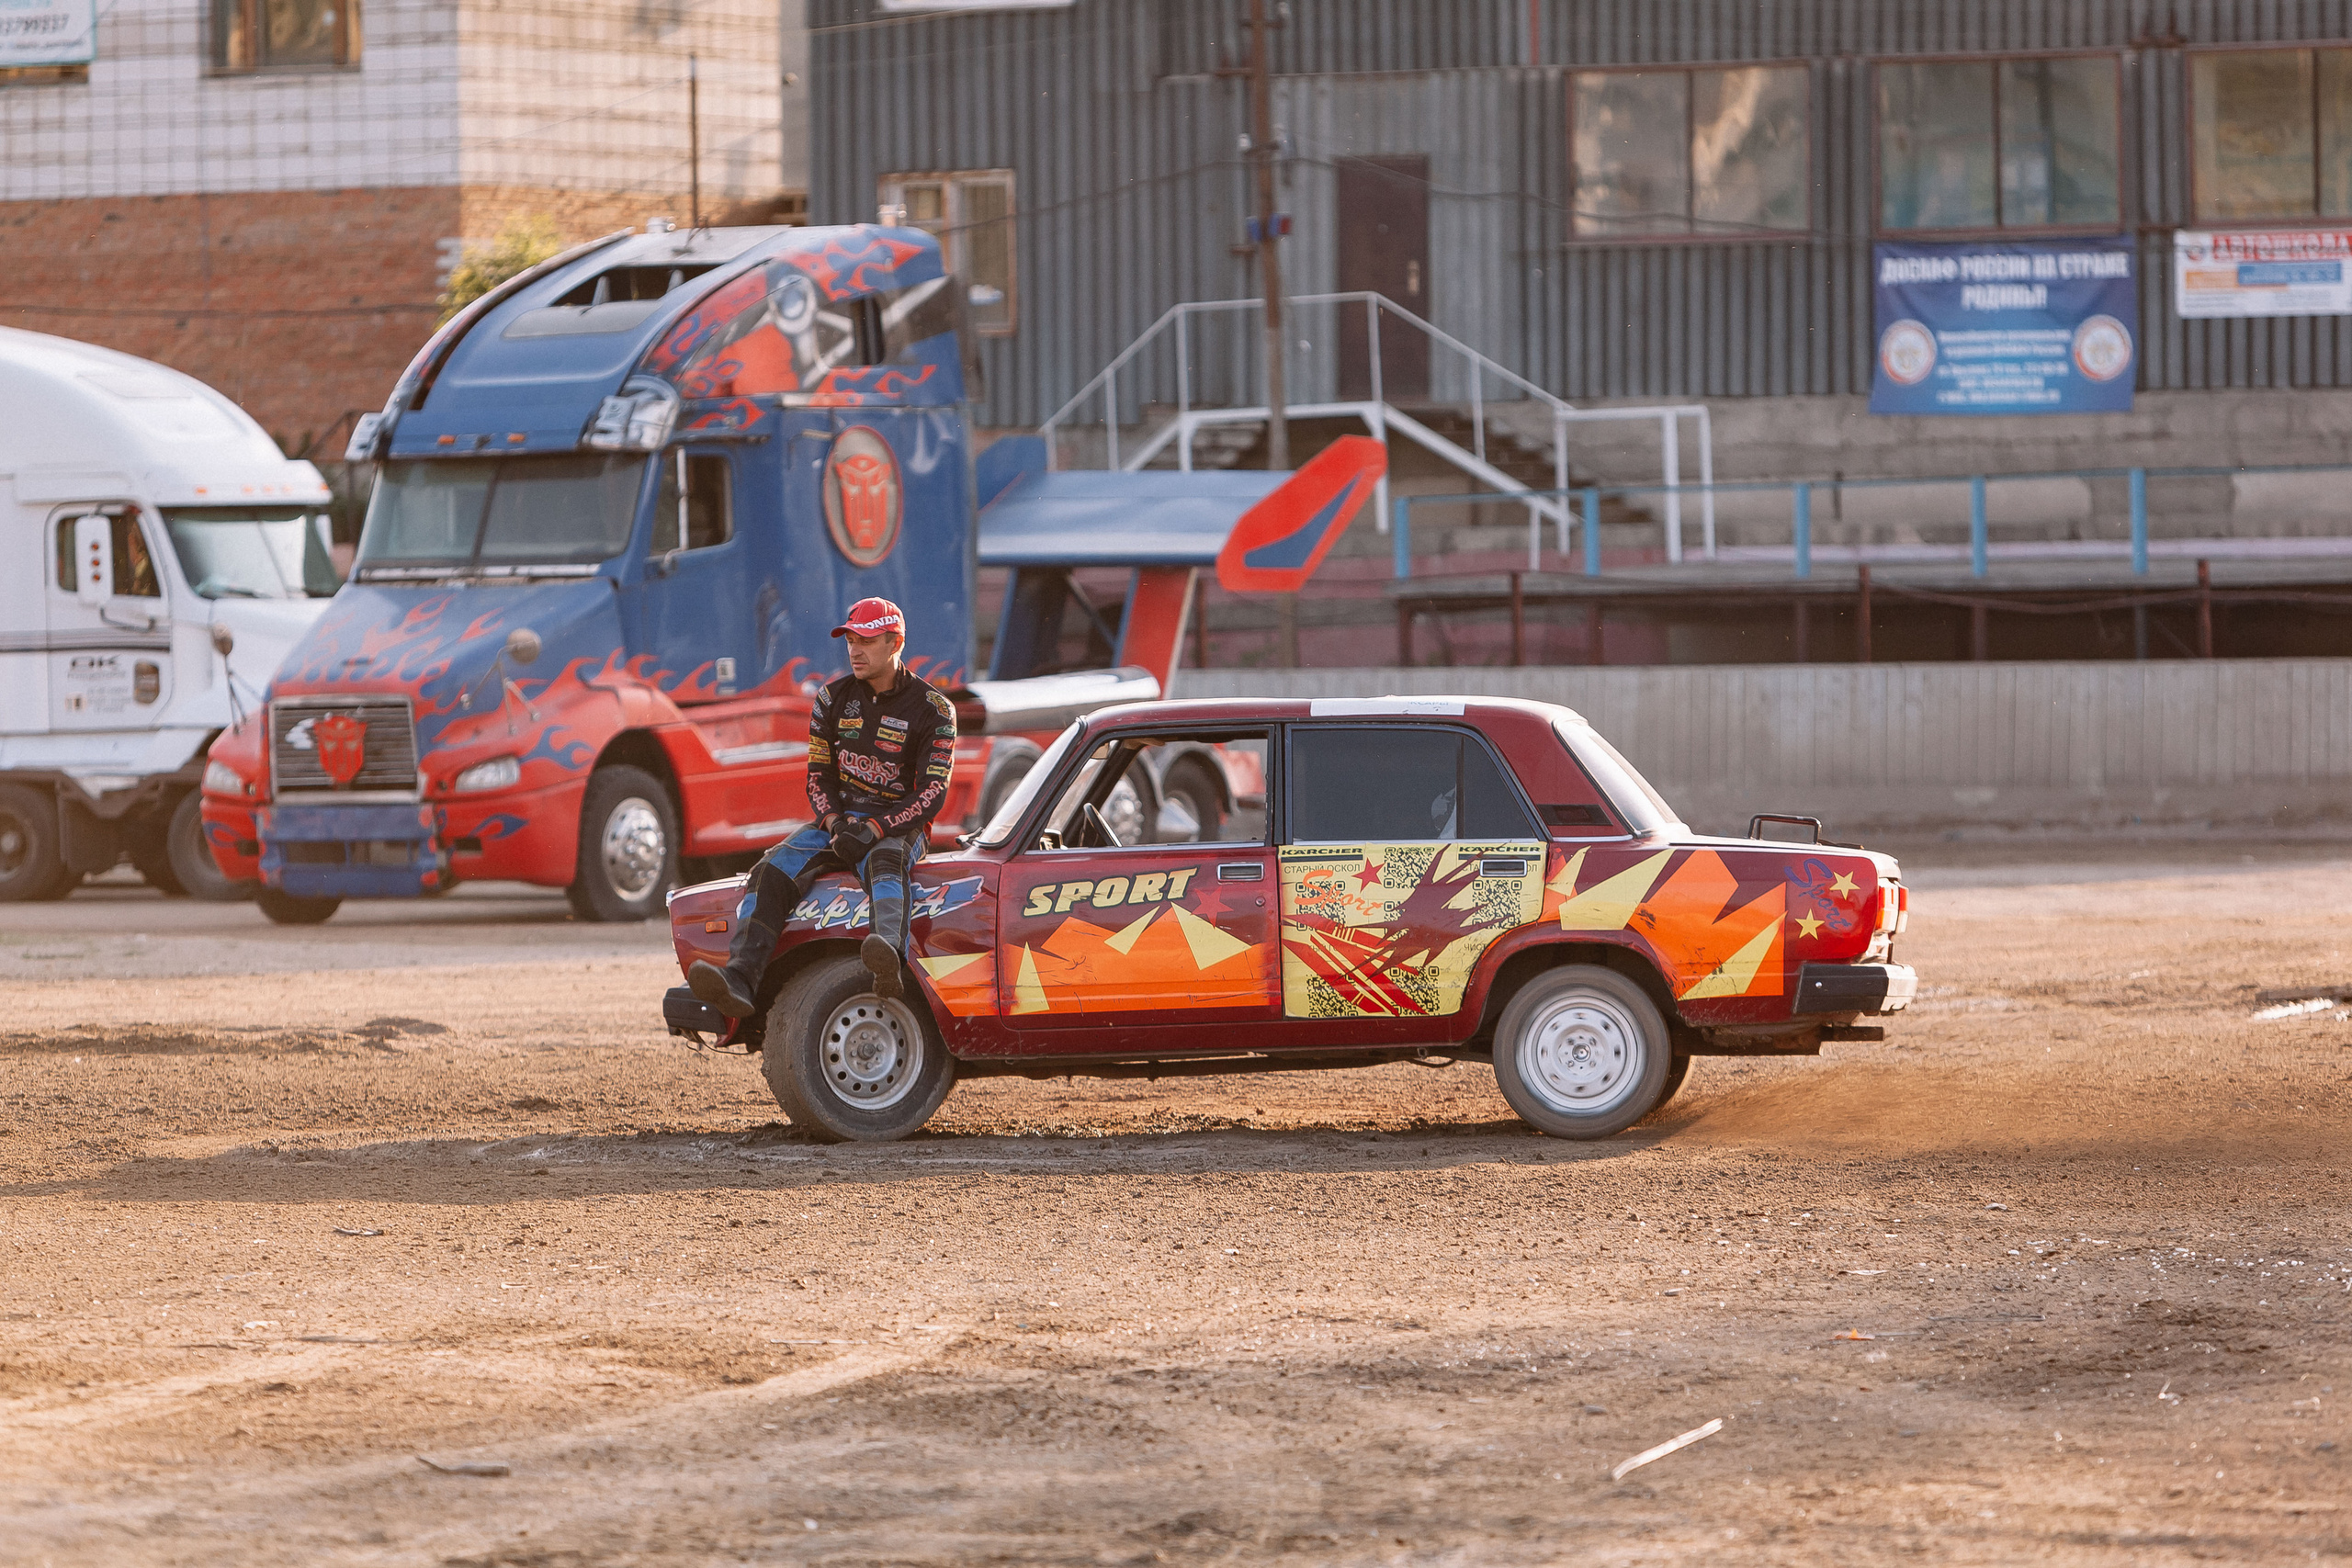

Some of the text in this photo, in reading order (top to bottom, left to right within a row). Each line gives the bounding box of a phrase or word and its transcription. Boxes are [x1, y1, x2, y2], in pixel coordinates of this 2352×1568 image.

[1959, 254, 2030, 279] РОССИИ
[2031, 253, 2057, 278] НА
[2058, 252, 2130, 278] СТРАЖЕ
[851, 615, 900, 629] HONDA
[884, 780, 941, 828] Lucky John
[1023, 866, 1199, 918] SPORT
[1283, 863, 1361, 874] СТАРЫЙ ОСКОЛ
[1294, 869, 1384, 917] Sport
[1783, 858, 1852, 931] Sport
